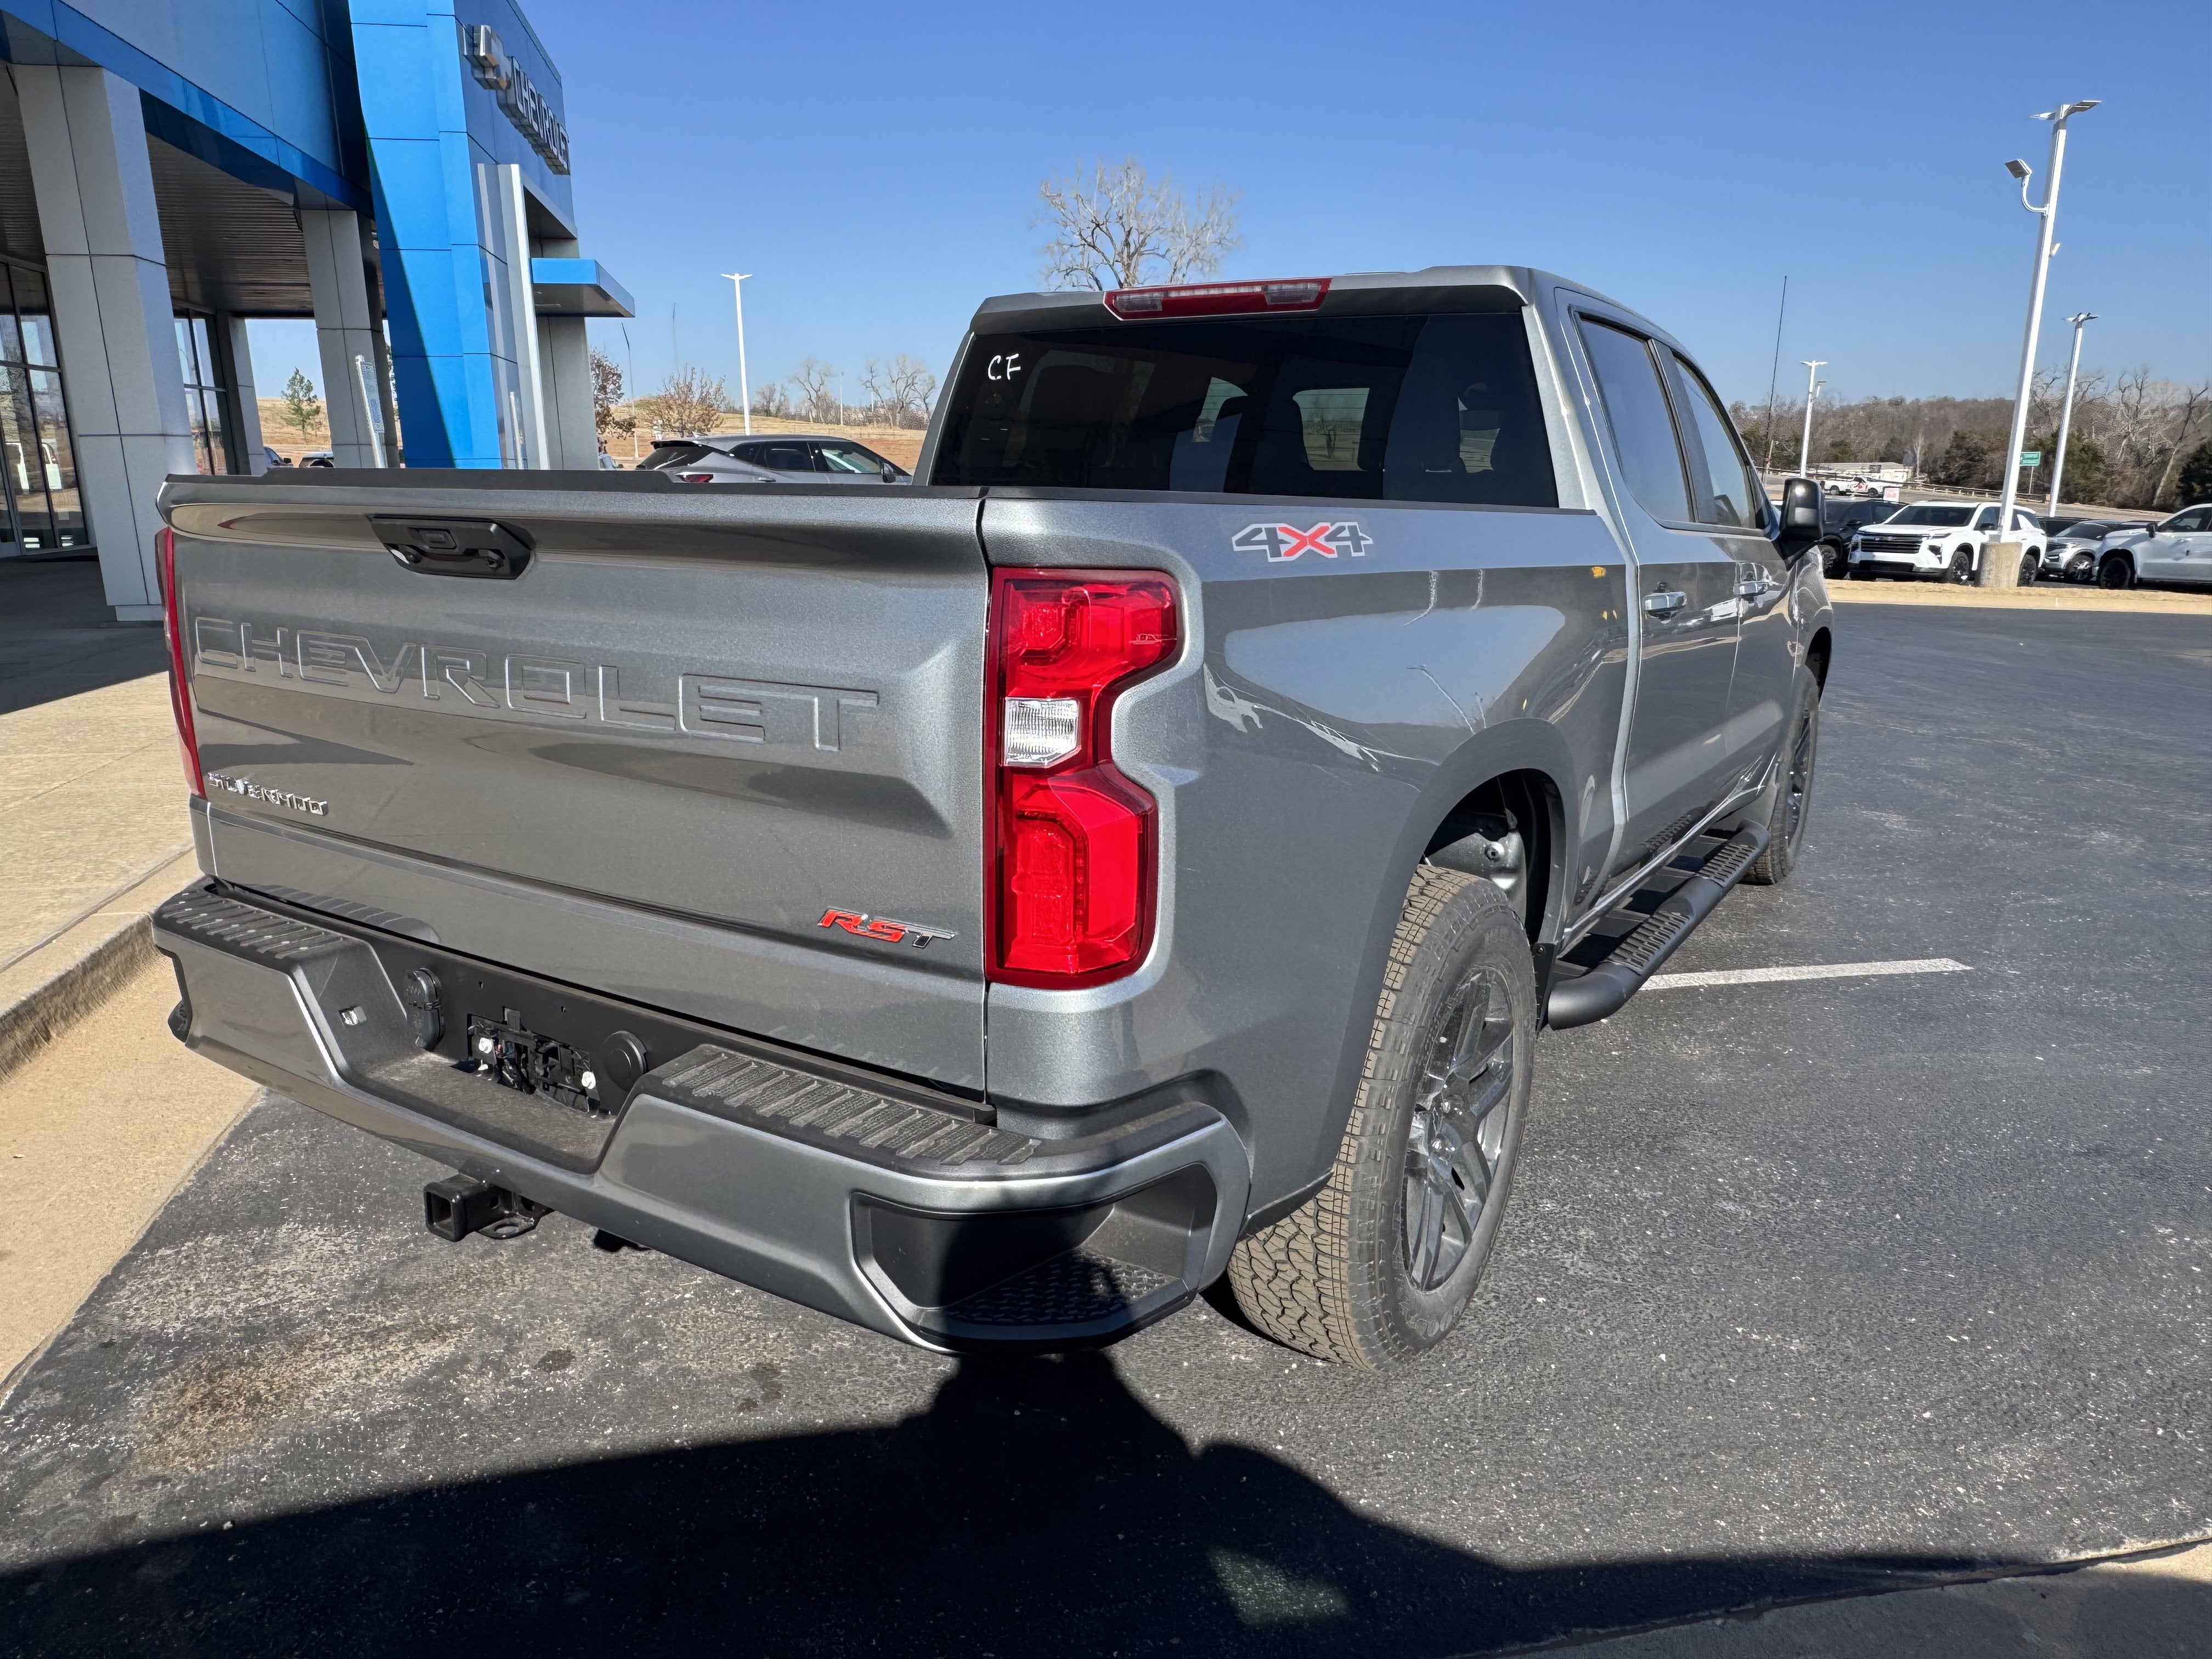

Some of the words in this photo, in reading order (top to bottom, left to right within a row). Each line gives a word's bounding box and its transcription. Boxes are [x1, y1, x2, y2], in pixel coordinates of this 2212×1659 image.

[988, 353, 1020, 380] CF
[195, 617, 879, 752] CHEVROLET
[817, 906, 957, 949] RST
